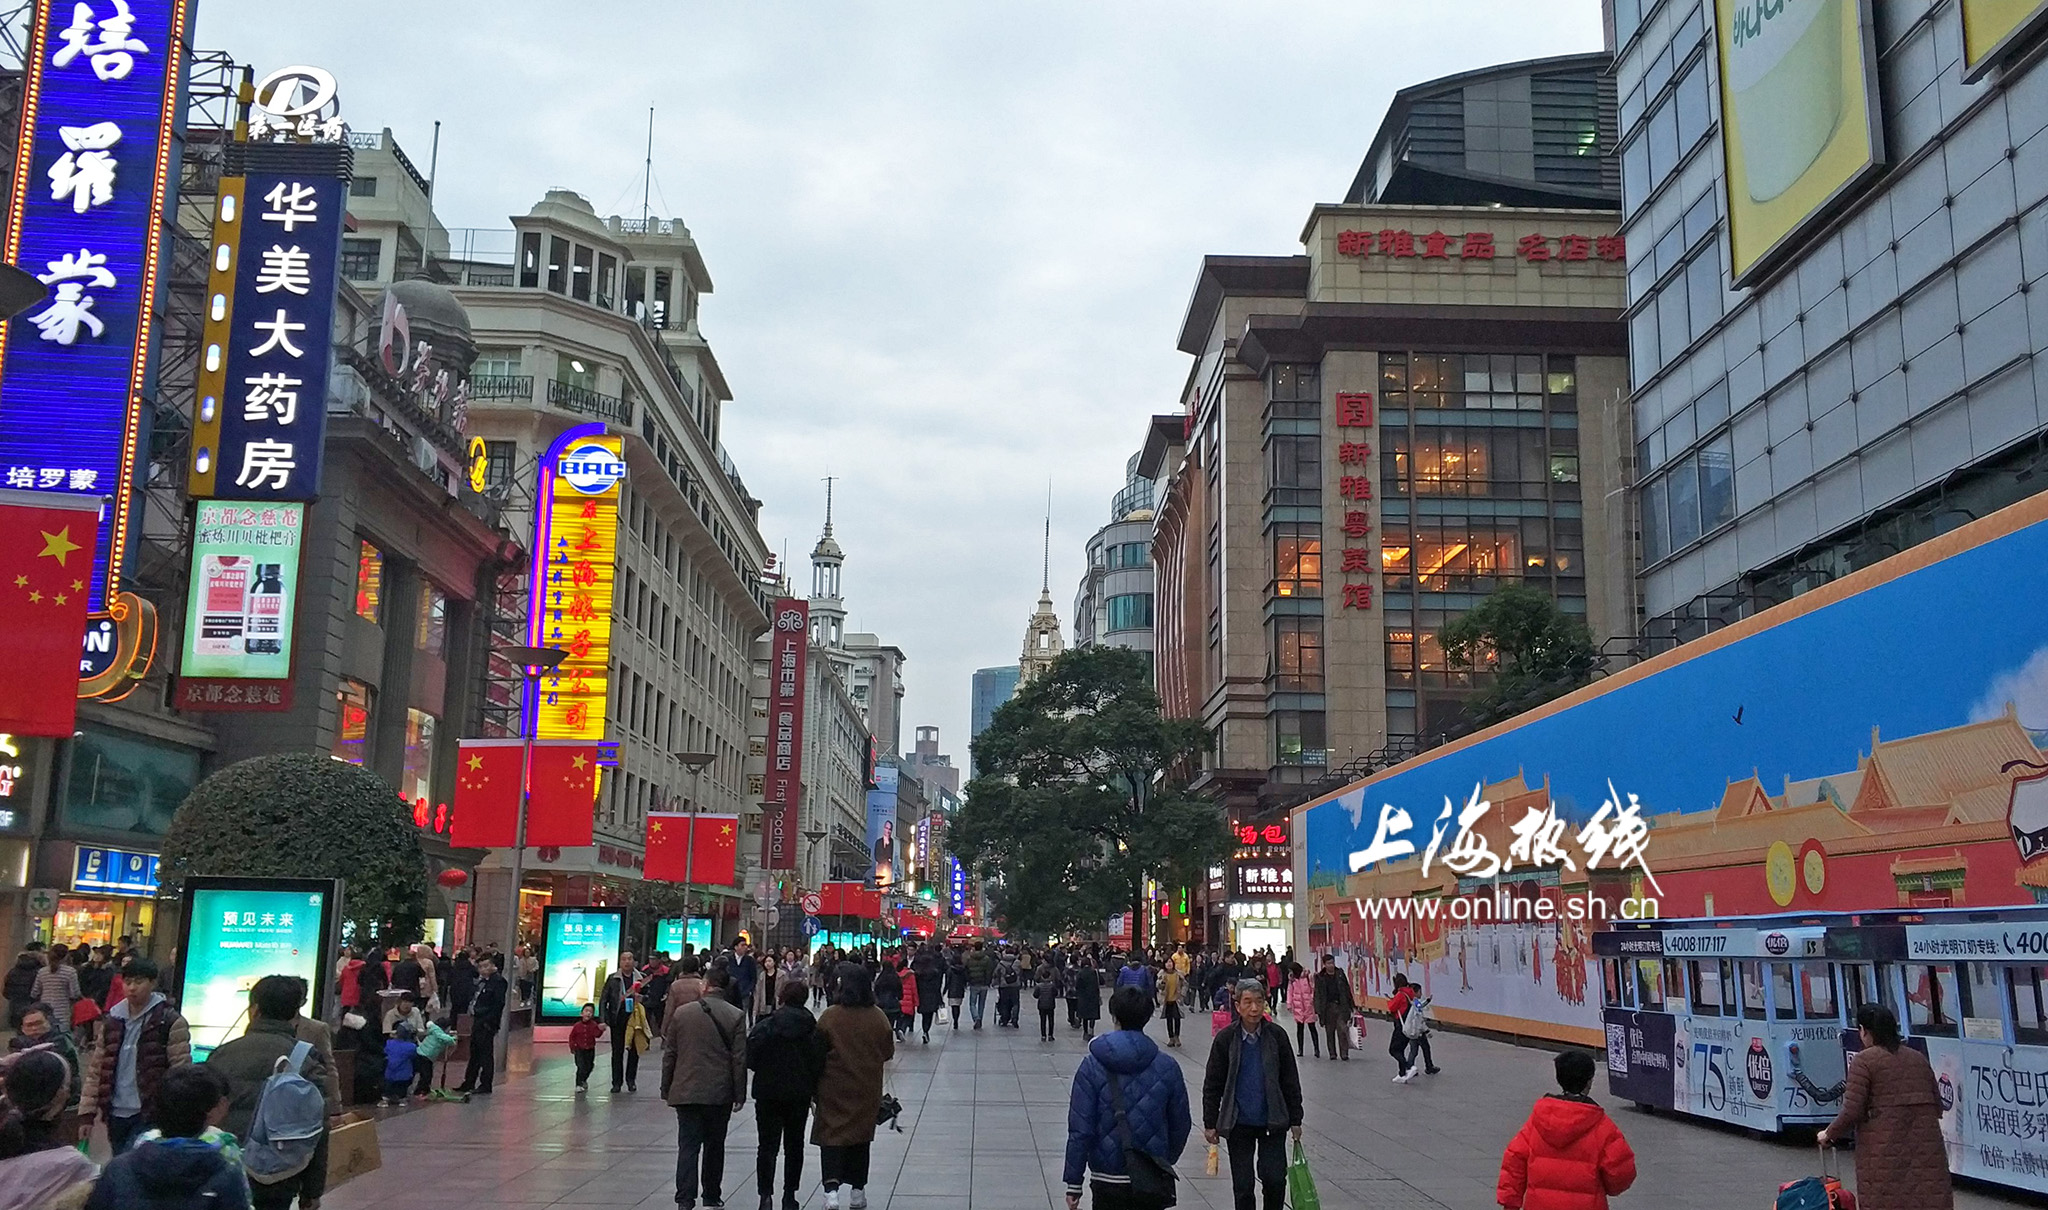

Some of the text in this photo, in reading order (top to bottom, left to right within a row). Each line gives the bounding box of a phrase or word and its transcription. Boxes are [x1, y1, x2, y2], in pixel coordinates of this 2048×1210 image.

[1337, 229, 1496, 260] 新雅食品
[235, 181, 318, 490] 华美大药房
[6, 466, 99, 490] 培罗蒙
[560, 462, 625, 477] BAC
[1339, 442, 1374, 610] 新雅粤菜馆
[82, 630, 112, 652] N
[775, 638, 798, 771] 上海市第一食品商店
[772, 779, 788, 859] First oodhall
[1240, 825, 1287, 845] 汤包
[223, 911, 294, 927] 预见未来
[1748, 1054, 1771, 1081] 优倍
